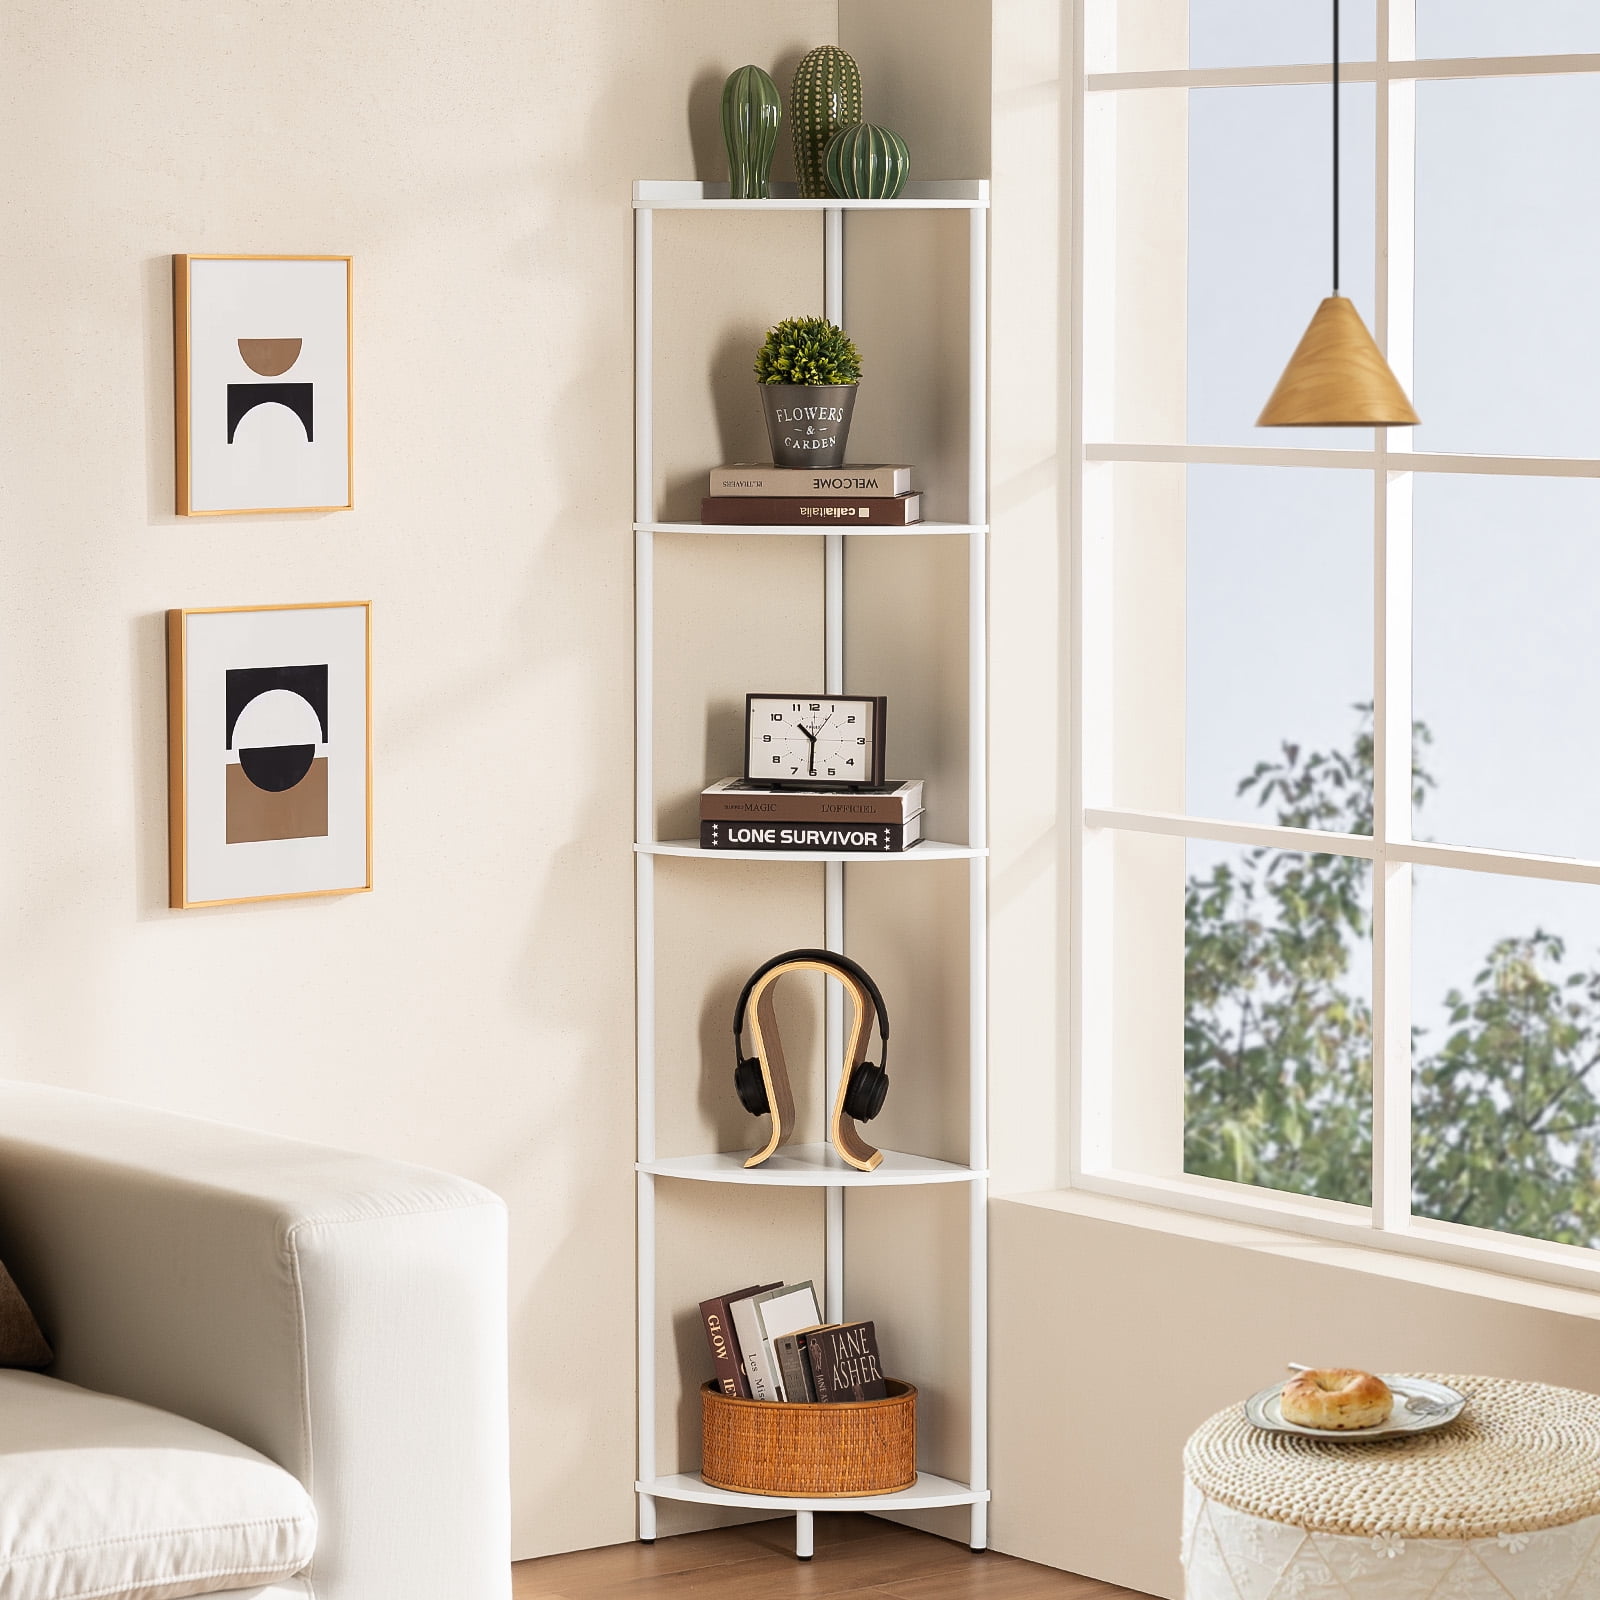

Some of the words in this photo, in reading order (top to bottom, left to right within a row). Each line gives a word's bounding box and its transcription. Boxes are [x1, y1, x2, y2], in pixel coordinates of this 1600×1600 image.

[776, 406, 844, 423] FLOWERS
[784, 435, 836, 450] GARDEN
[813, 478, 879, 489] WELCOME
[799, 507, 856, 518] caliaitalia
[792, 703, 801, 712] 11
[809, 703, 821, 712] 12
[831, 704, 835, 713] 1
[770, 713, 783, 722] 10
[847, 715, 856, 724] 2
[762, 734, 772, 743] 9
[856, 737, 866, 745] 3
[772, 755, 781, 764] 8
[845, 758, 855, 767] 4
[790, 767, 799, 775] 7
[827, 767, 836, 776] 5
[744, 803, 777, 812] MAGIC
[821, 804, 877, 814] L'OFFICIEL
[728, 828, 776, 843] LONE
[780, 829, 878, 846] SURVIVOR
[707, 1314, 729, 1360] GLOW
[831, 1327, 870, 1367] JANE
[748, 1353, 758, 1372] Les
[833, 1354, 883, 1391] ASHER
